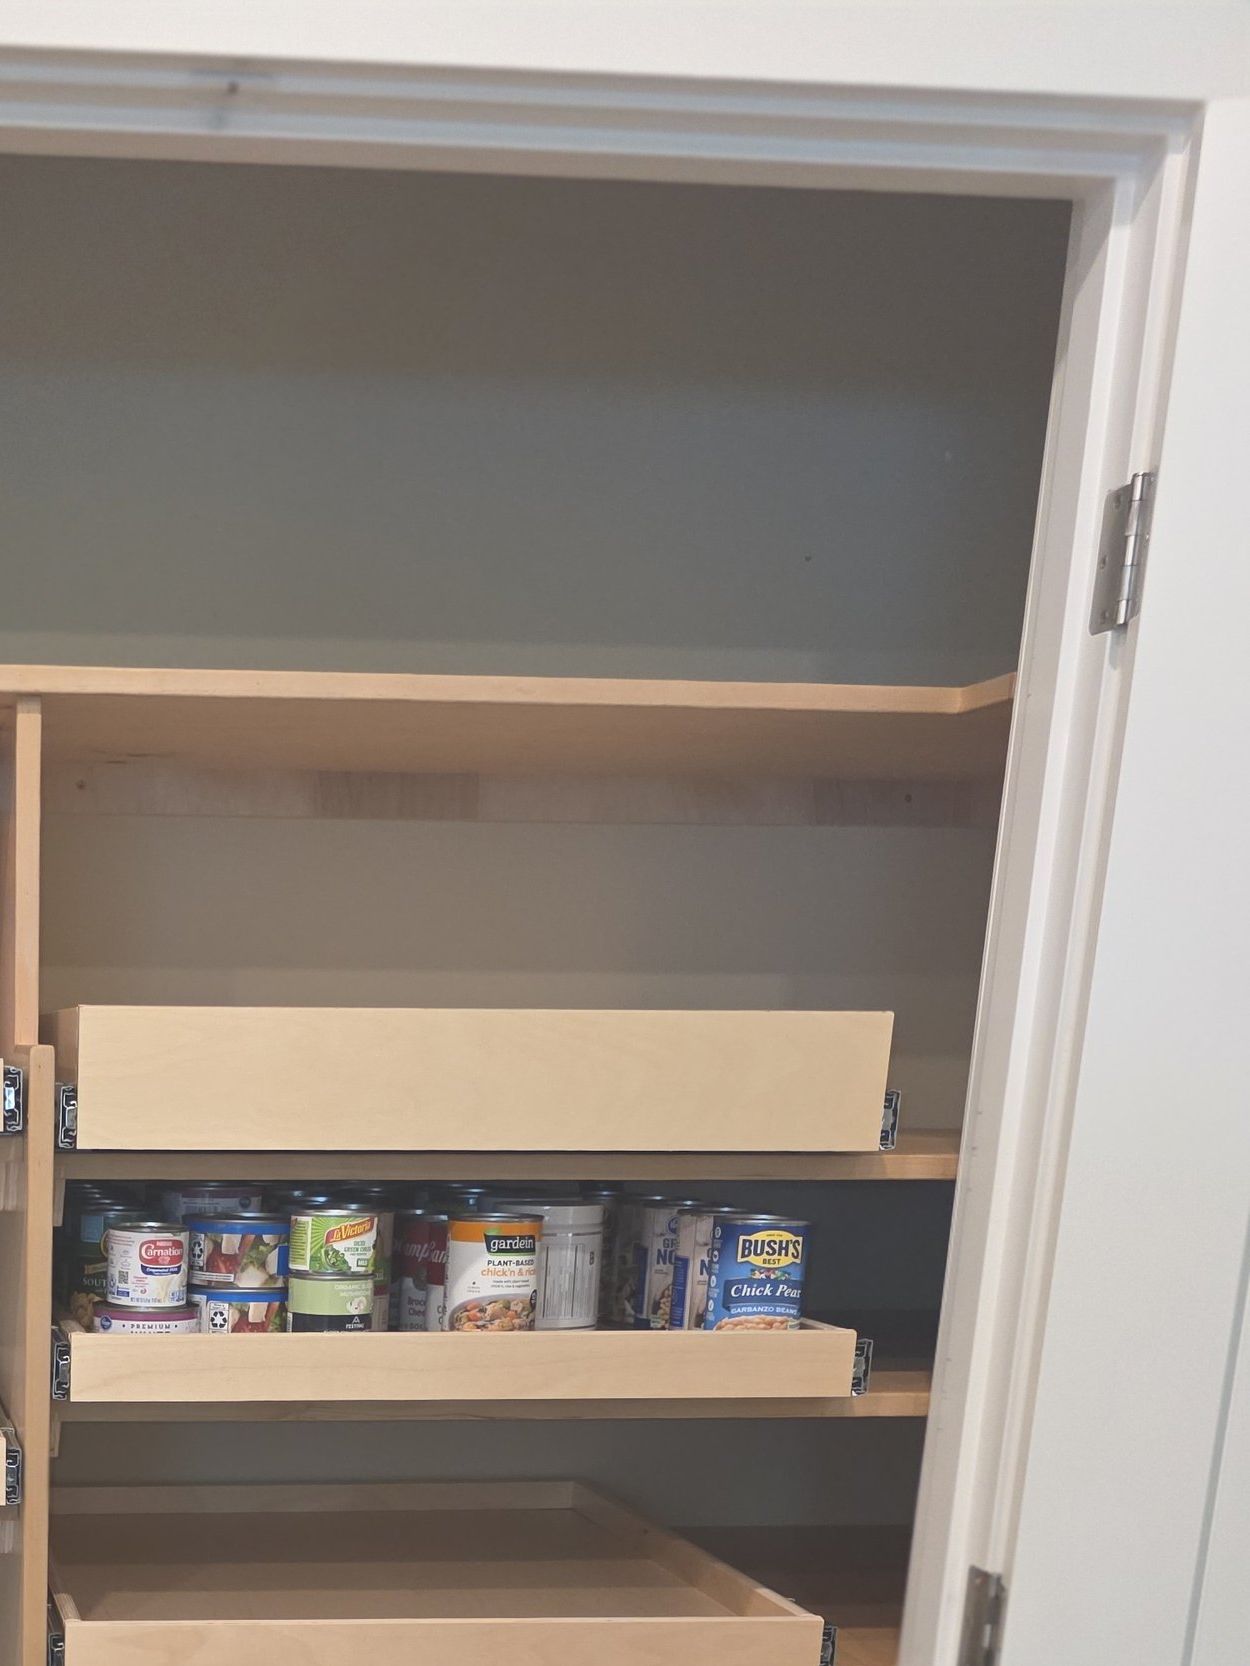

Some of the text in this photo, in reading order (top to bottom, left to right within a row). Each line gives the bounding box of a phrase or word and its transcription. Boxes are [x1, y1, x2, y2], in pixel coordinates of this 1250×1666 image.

[490, 1236, 533, 1252] gardein
[740, 1238, 801, 1260] BUSH'S
[141, 1243, 183, 1260] Carnation
[487, 1258, 535, 1267] PLANT-BASED
[481, 1268, 515, 1277] chick'n
[730, 1283, 802, 1299] Chick Peas
[730, 1306, 798, 1316] GARBANZO BEANS
[130, 1322, 171, 1330] PREMIUM
